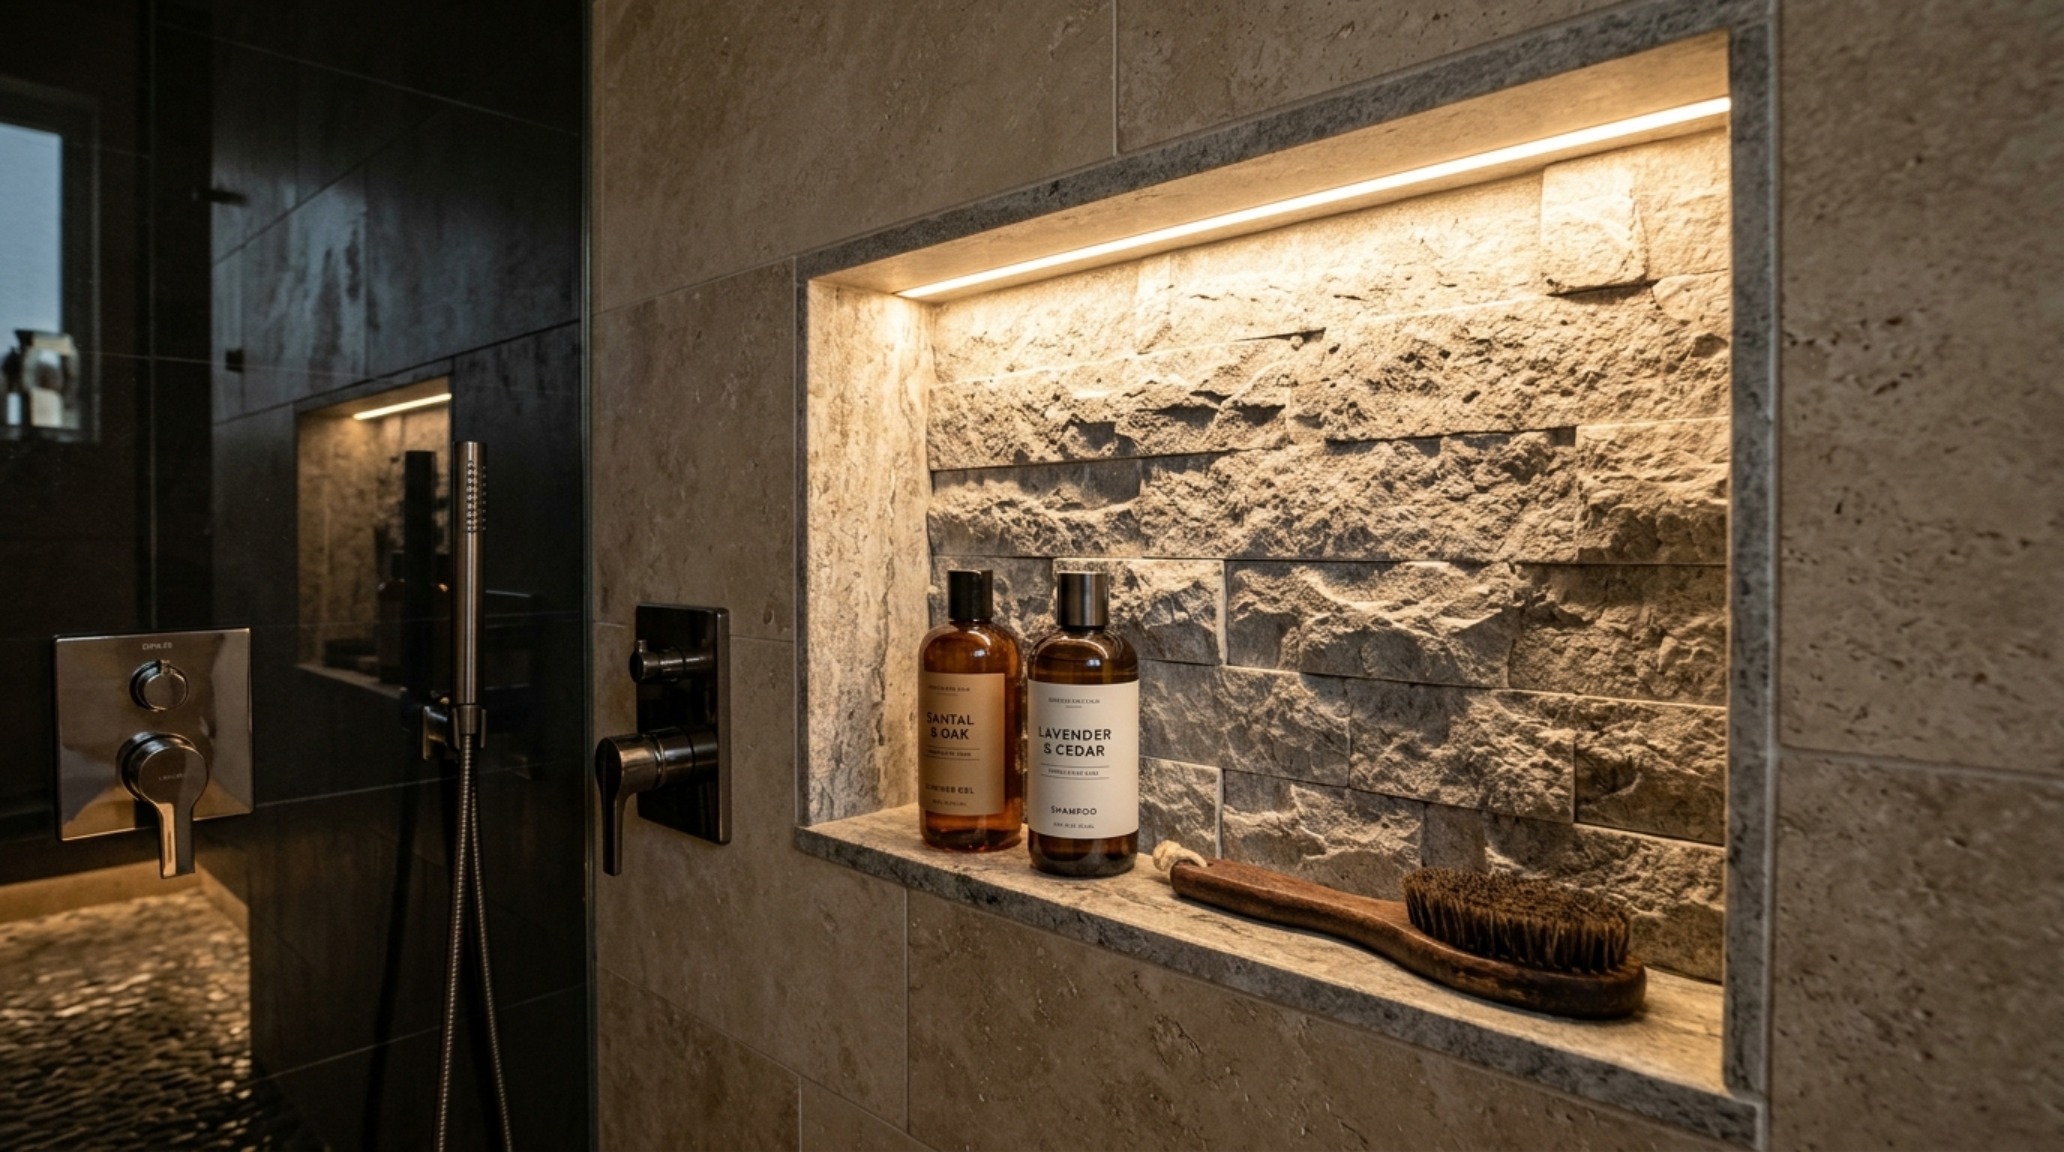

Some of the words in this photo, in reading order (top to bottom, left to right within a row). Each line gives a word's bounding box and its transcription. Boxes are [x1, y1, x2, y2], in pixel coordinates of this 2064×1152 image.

[926, 712, 974, 725] SANTAL
[941, 728, 969, 740] OAK
[1038, 726, 1111, 741] LAVENDER
[1055, 744, 1105, 756] CEDAR
[1050, 805, 1097, 816] SHAMPOO
